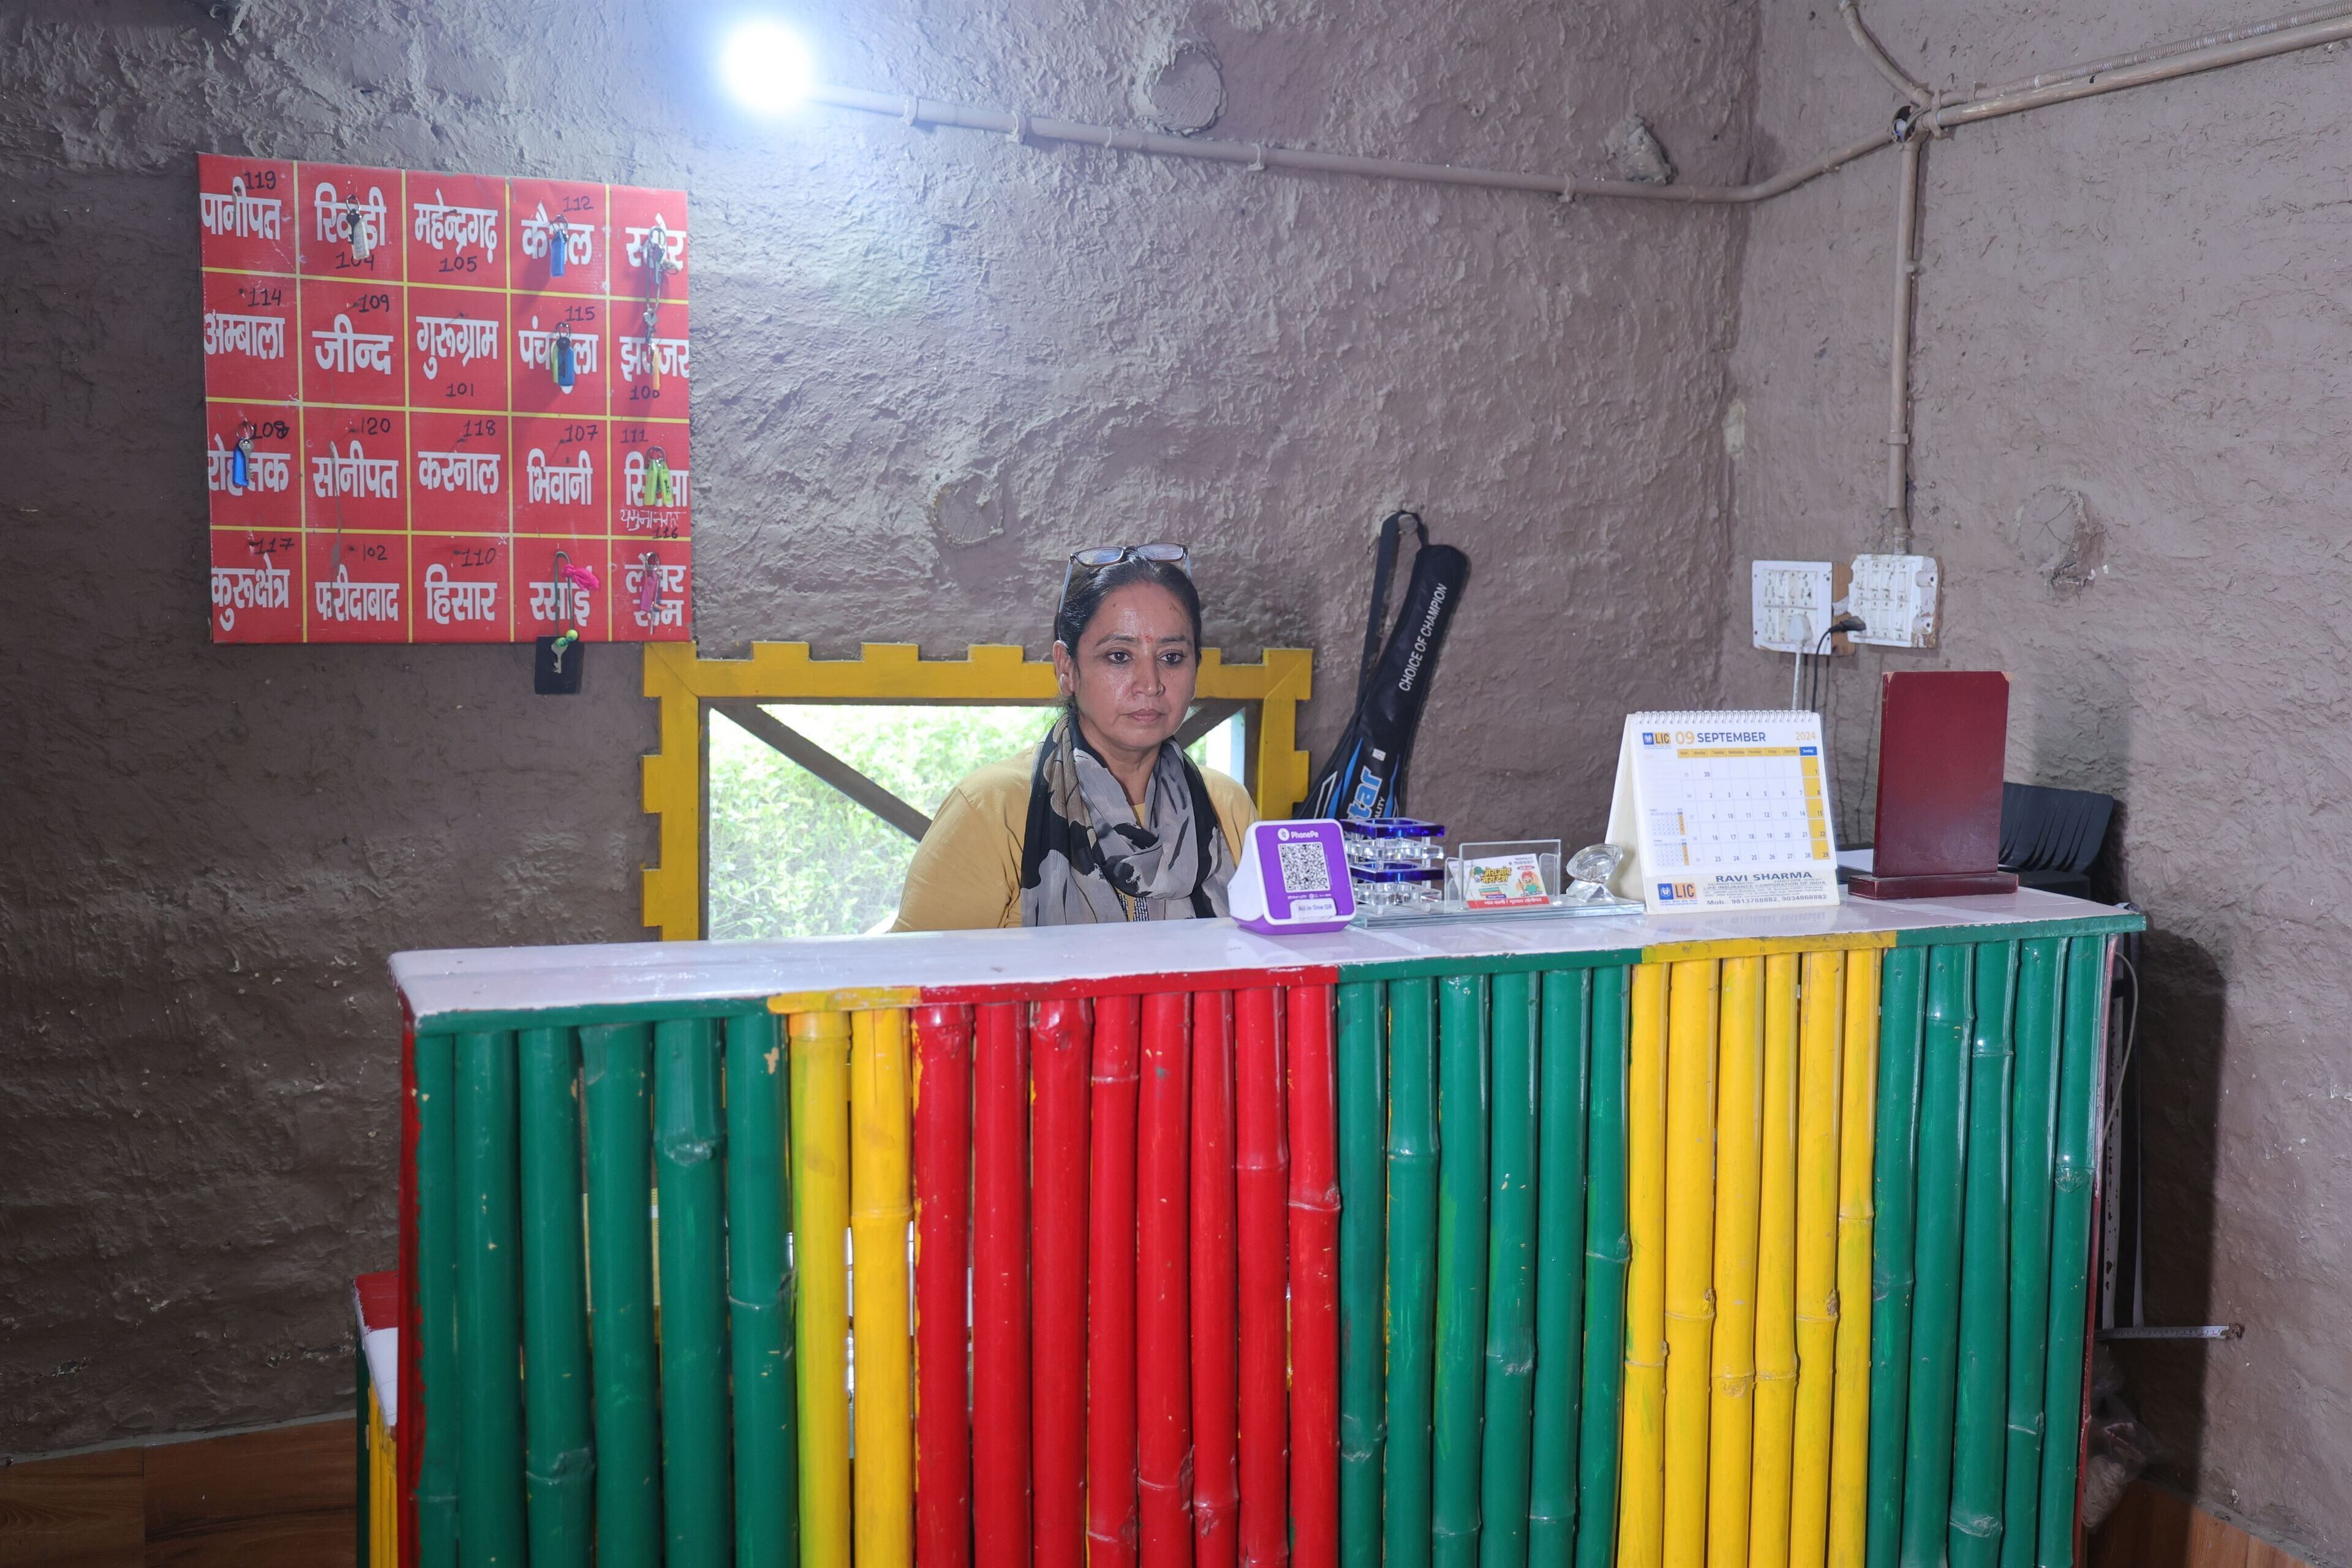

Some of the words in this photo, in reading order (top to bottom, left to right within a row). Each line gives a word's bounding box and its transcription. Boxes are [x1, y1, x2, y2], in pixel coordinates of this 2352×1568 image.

[245, 171, 277, 189] 119
[200, 176, 282, 240] पानीपत
[562, 195, 594, 212] 112
[521, 202, 595, 265] कैल
[438, 255, 478, 273] 105
[247, 288, 282, 307] 114
[358, 294, 390, 313] 109
[565, 306, 595, 322] 115
[312, 314, 394, 375] जीन्द
[445, 383, 474, 397] 101
[361, 417, 391, 436] 120
[463, 420, 496, 437] 118
[565, 424, 599, 443] 107
[620, 429, 649, 443] 111
[312, 440, 399, 499] सोनीपत
[418, 451, 501, 494] करनाल
[527, 448, 593, 505] भिवानी
[652, 526, 679, 539] 116
[252, 537, 295, 554] 117
[363, 545, 388, 562] 102
[461, 548, 496, 567] 110
[315, 564, 400, 622] फरीदाबाद
[424, 564, 497, 624] हिसार
[1420, 582, 1447, 637] CHAMPION
[1414, 635, 1428, 652] OF
[1398, 650, 1423, 692] CHOICE
[1655, 733, 1671, 745] LIC
[1675, 731, 1695, 745] 09
[1697, 731, 1766, 743] SEPTEMBER
[1795, 731, 1817, 741] 2024
[1347, 764, 1382, 820] tar
[1374, 796, 1385, 819] ALITY
[1291, 830, 1319, 839] PhonePe
[1481, 875, 1495, 883] मेरा
[1496, 874, 1509, 883] देश
[1484, 867, 1497, 876] मेरा
[1753, 872, 1813, 881] SHARMA
[1675, 884, 1695, 898] LIC
